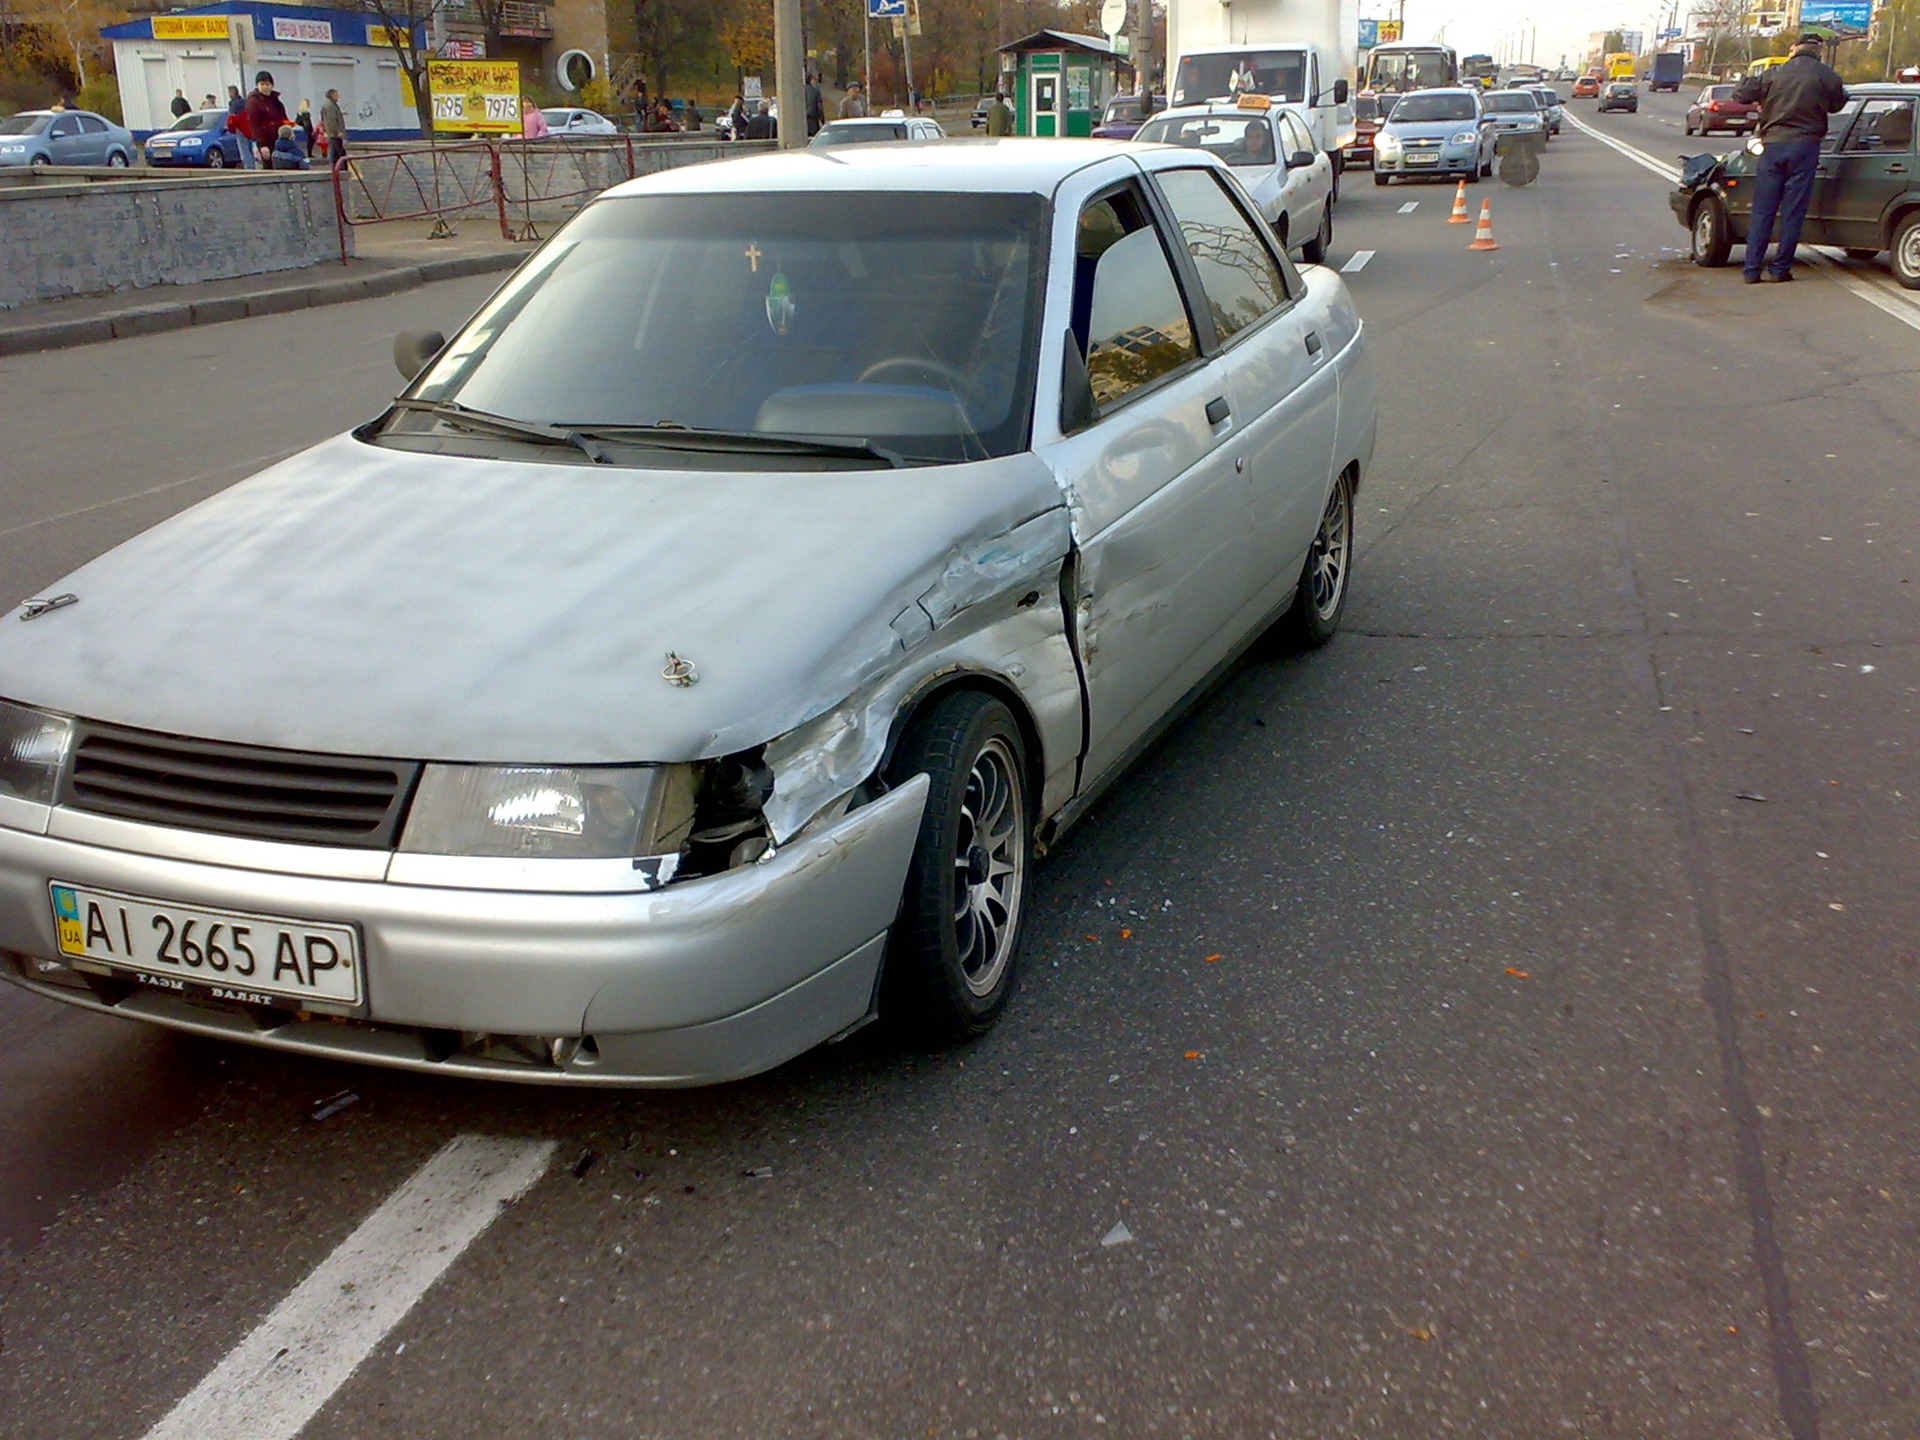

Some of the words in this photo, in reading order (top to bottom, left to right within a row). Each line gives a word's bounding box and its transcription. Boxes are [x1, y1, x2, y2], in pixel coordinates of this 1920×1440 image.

[486, 98, 517, 117] 7975
[63, 928, 83, 946] UA
[86, 900, 133, 956] AI
[152, 913, 256, 977] 2665
[273, 930, 339, 986] AP
[211, 987, 273, 1005] ВАЛЯТ
